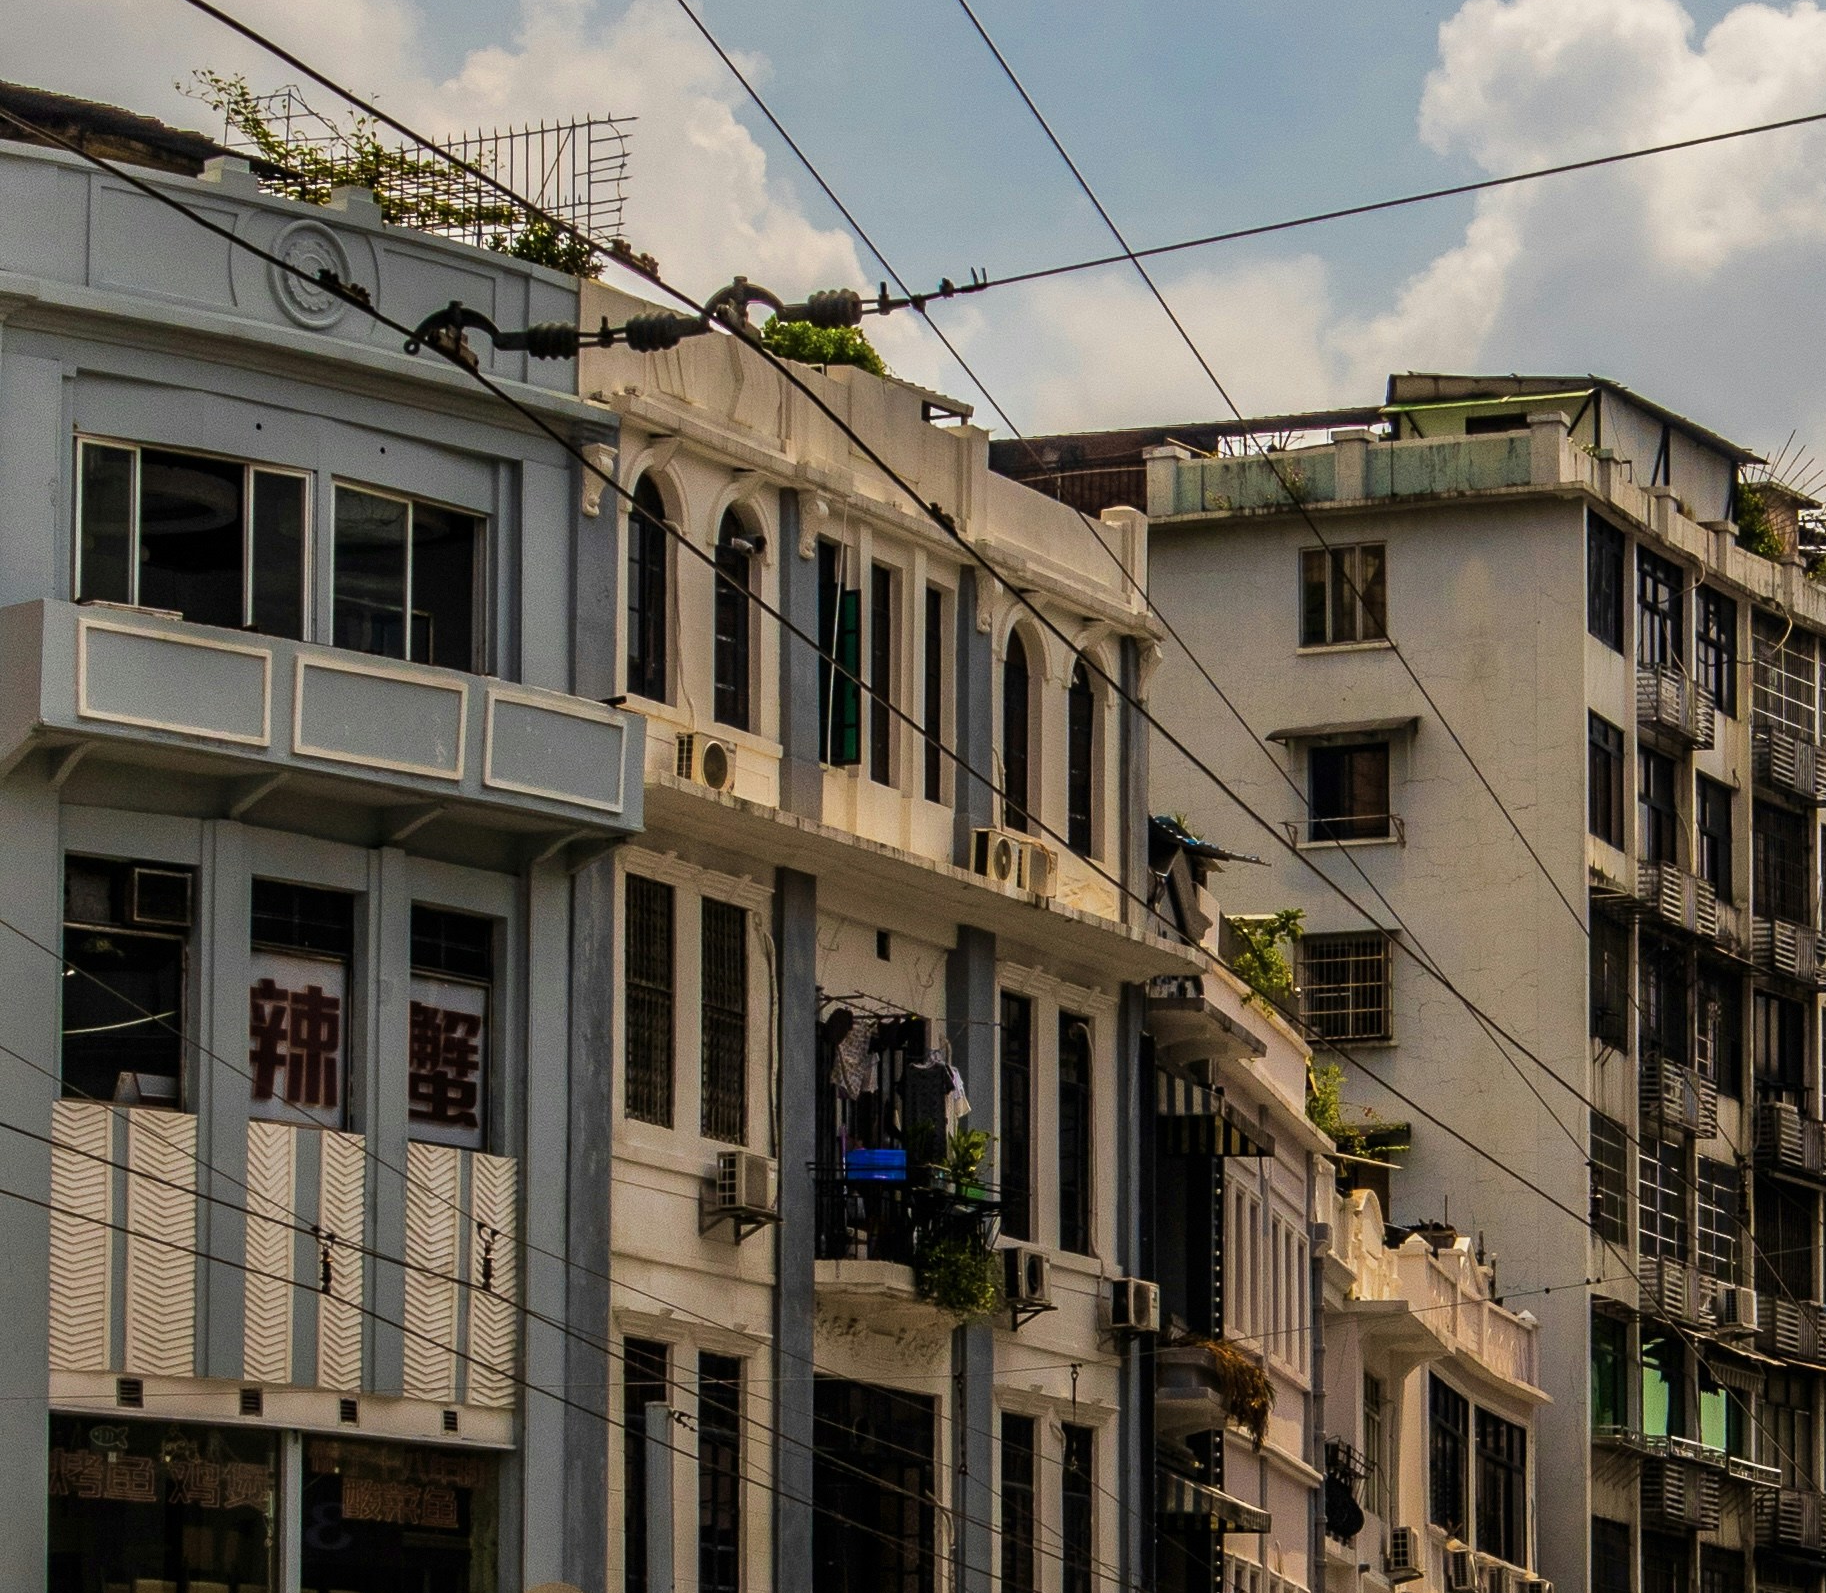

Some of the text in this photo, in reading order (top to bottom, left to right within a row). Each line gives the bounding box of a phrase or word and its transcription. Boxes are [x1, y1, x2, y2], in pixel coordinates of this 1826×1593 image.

[249, 978, 482, 1129] 辣 蟹
[49, 1446, 157, 1503] 烤鱼
[341, 1477, 460, 1530] 酸菜鱼
